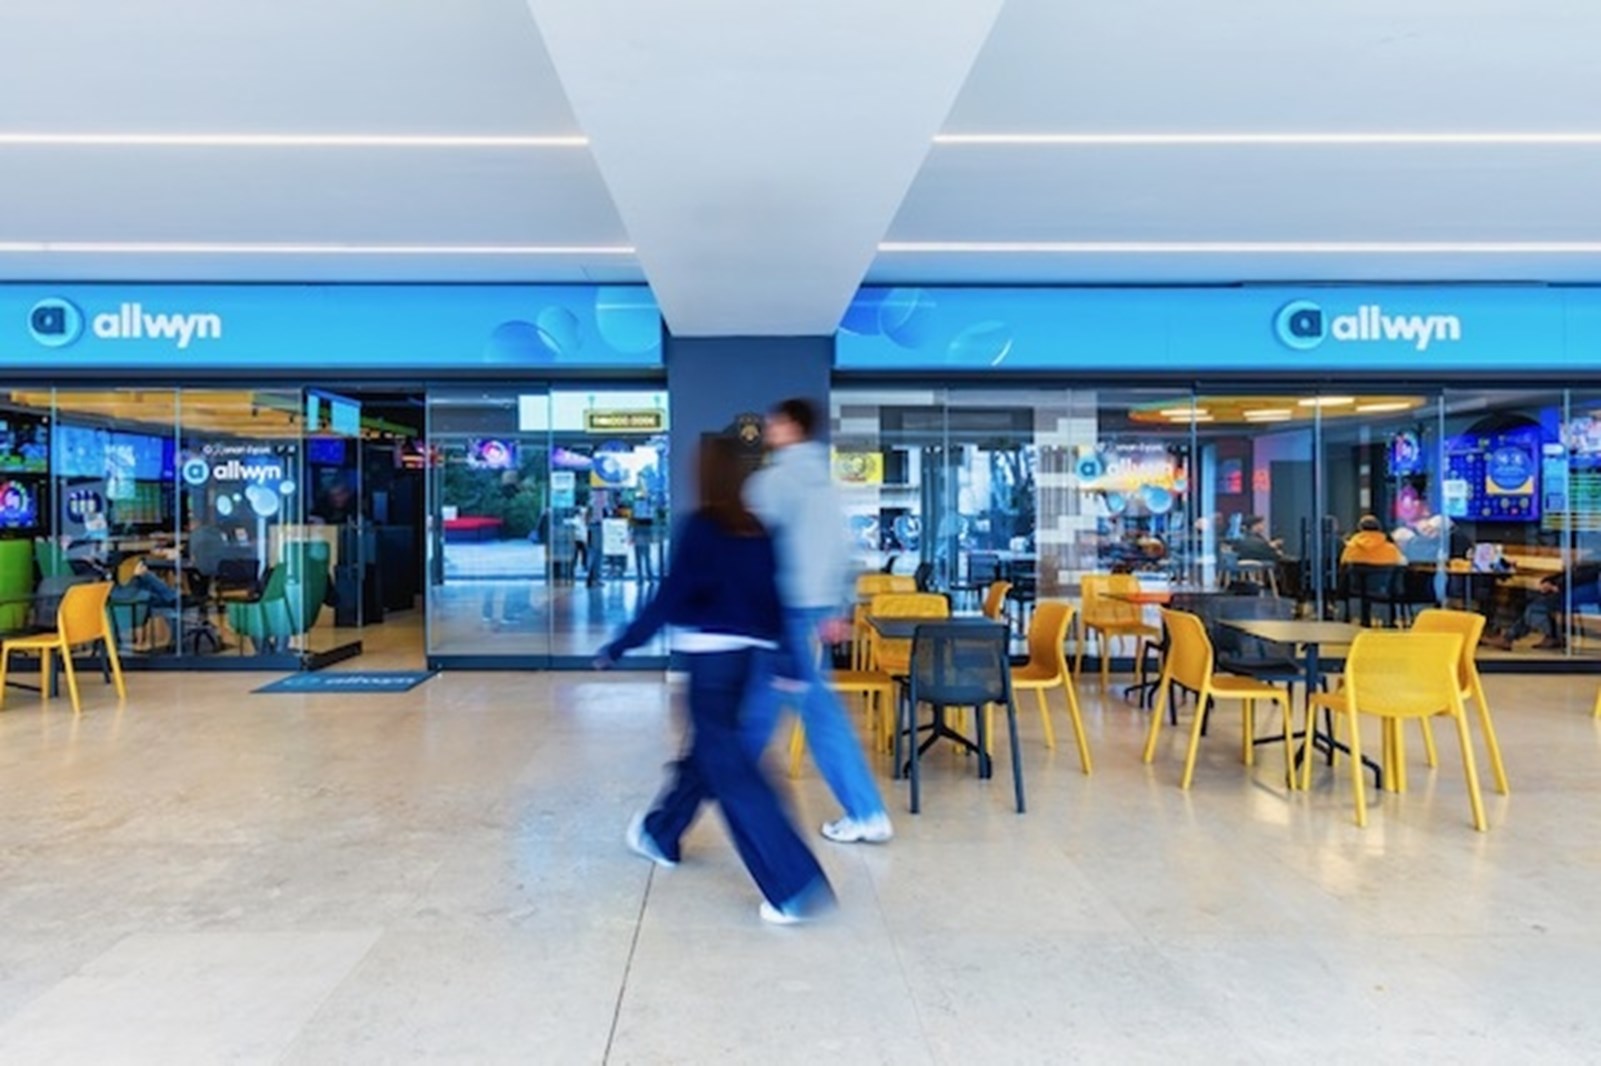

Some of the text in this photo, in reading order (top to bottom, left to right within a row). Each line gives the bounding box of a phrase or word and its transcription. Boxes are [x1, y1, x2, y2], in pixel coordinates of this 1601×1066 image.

[93, 303, 221, 348] allwyn
[1332, 305, 1461, 350] allwyn
[213, 460, 281, 485] allwyn
